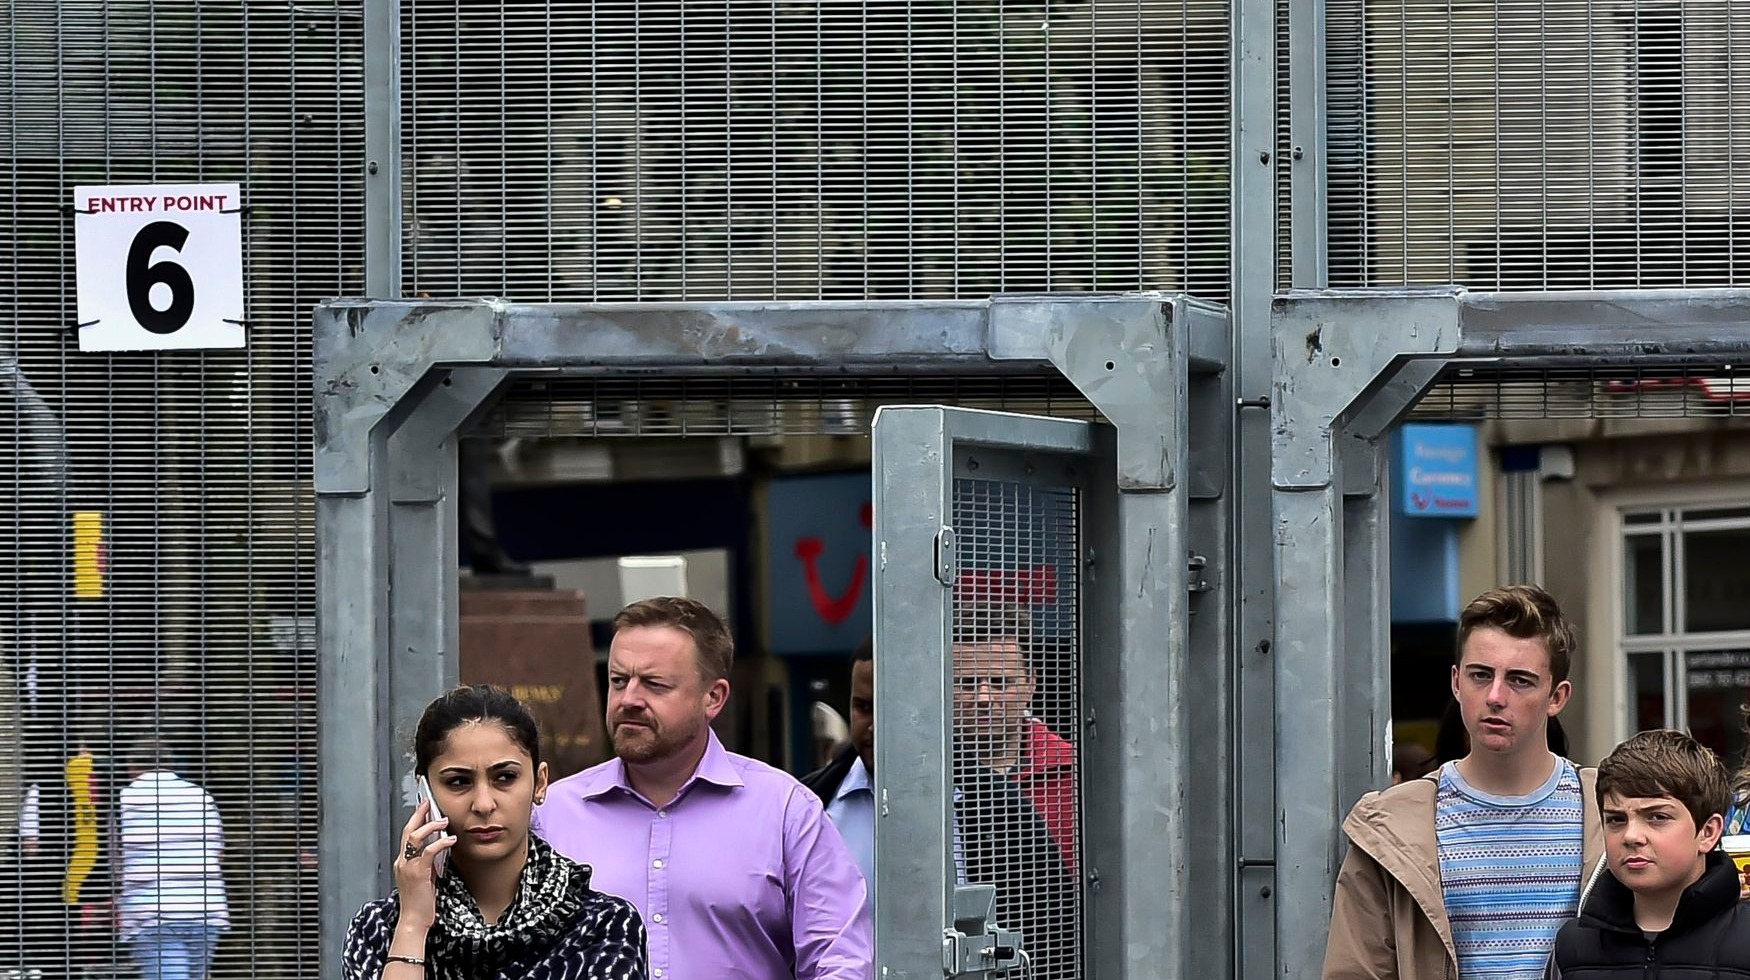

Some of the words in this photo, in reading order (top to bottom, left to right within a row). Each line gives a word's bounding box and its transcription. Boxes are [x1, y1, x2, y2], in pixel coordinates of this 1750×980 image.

[88, 197, 157, 213] ENTRY
[163, 195, 227, 212] POINT
[126, 220, 195, 335] 6
